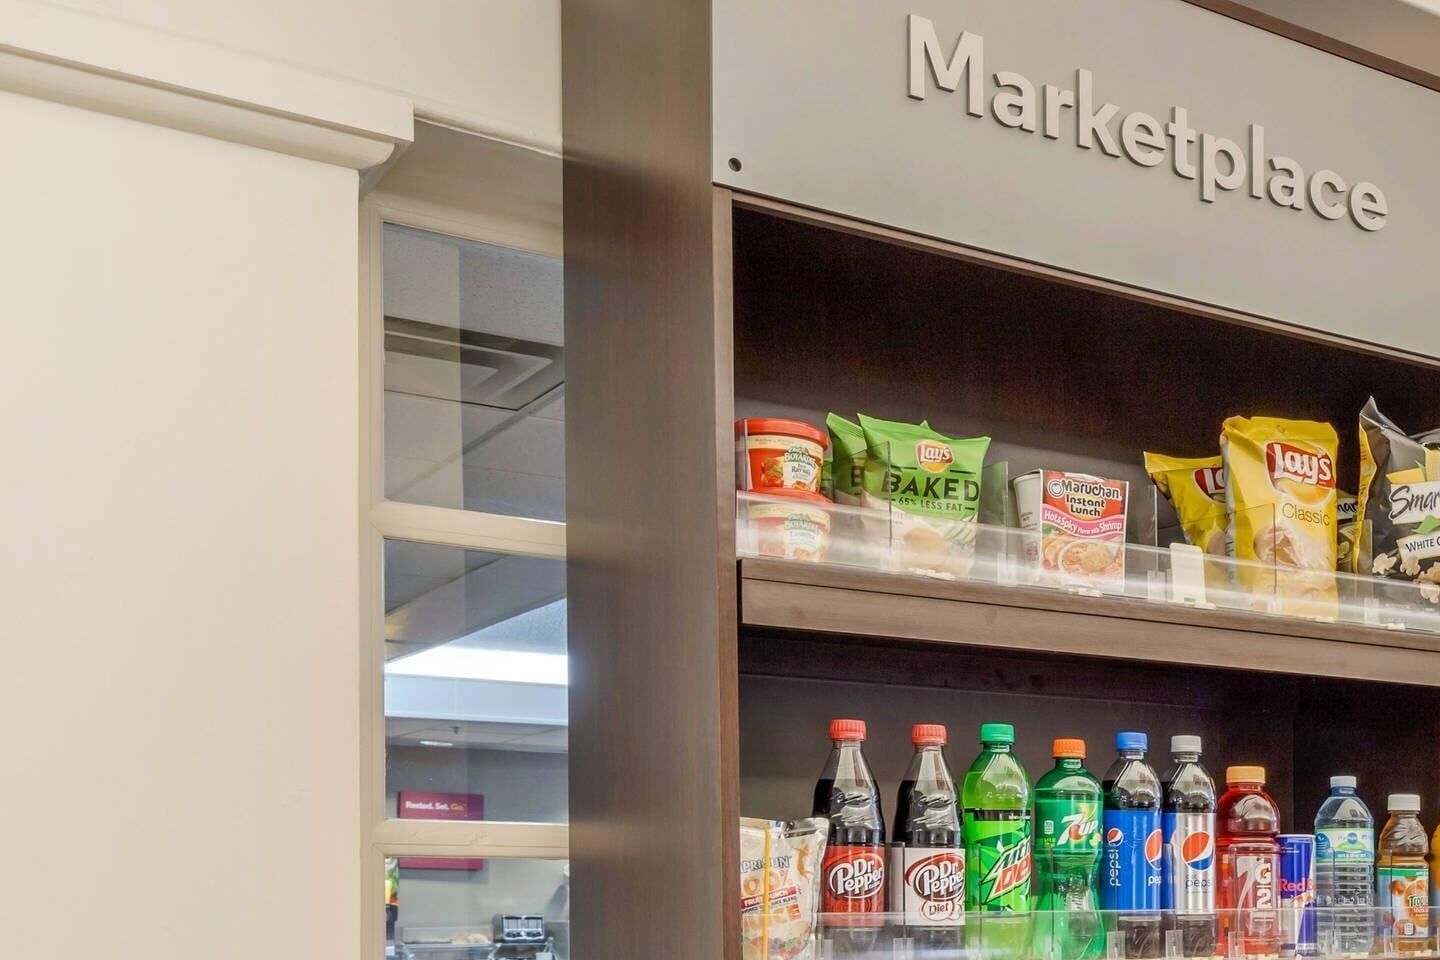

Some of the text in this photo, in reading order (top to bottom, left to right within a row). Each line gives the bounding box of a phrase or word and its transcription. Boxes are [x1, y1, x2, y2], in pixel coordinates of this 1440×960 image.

[906, 13, 1389, 232] Marketplace
[919, 444, 951, 463] Lay's
[1273, 443, 1332, 485] Lay's
[881, 471, 980, 502] BAKED
[1061, 479, 1120, 499] Maruchan
[898, 497, 963, 512] 65% LESS FAT
[1066, 494, 1105, 508] Instant
[1070, 504, 1101, 517] Lunch
[1281, 502, 1330, 526] Classic
[1099, 520, 1122, 532] Shrimp
[1405, 537, 1435, 553] WHITE
[852, 858, 875, 877] Dr
[938, 860, 959, 878] Dr
[1108, 847, 1121, 887] pepsi
[833, 862, 883, 895] Pepper
[920, 864, 965, 896] Peppe
[1185, 878, 1212, 888] peps
[1279, 876, 1306, 892] Red
[928, 903, 950, 916] Diet
